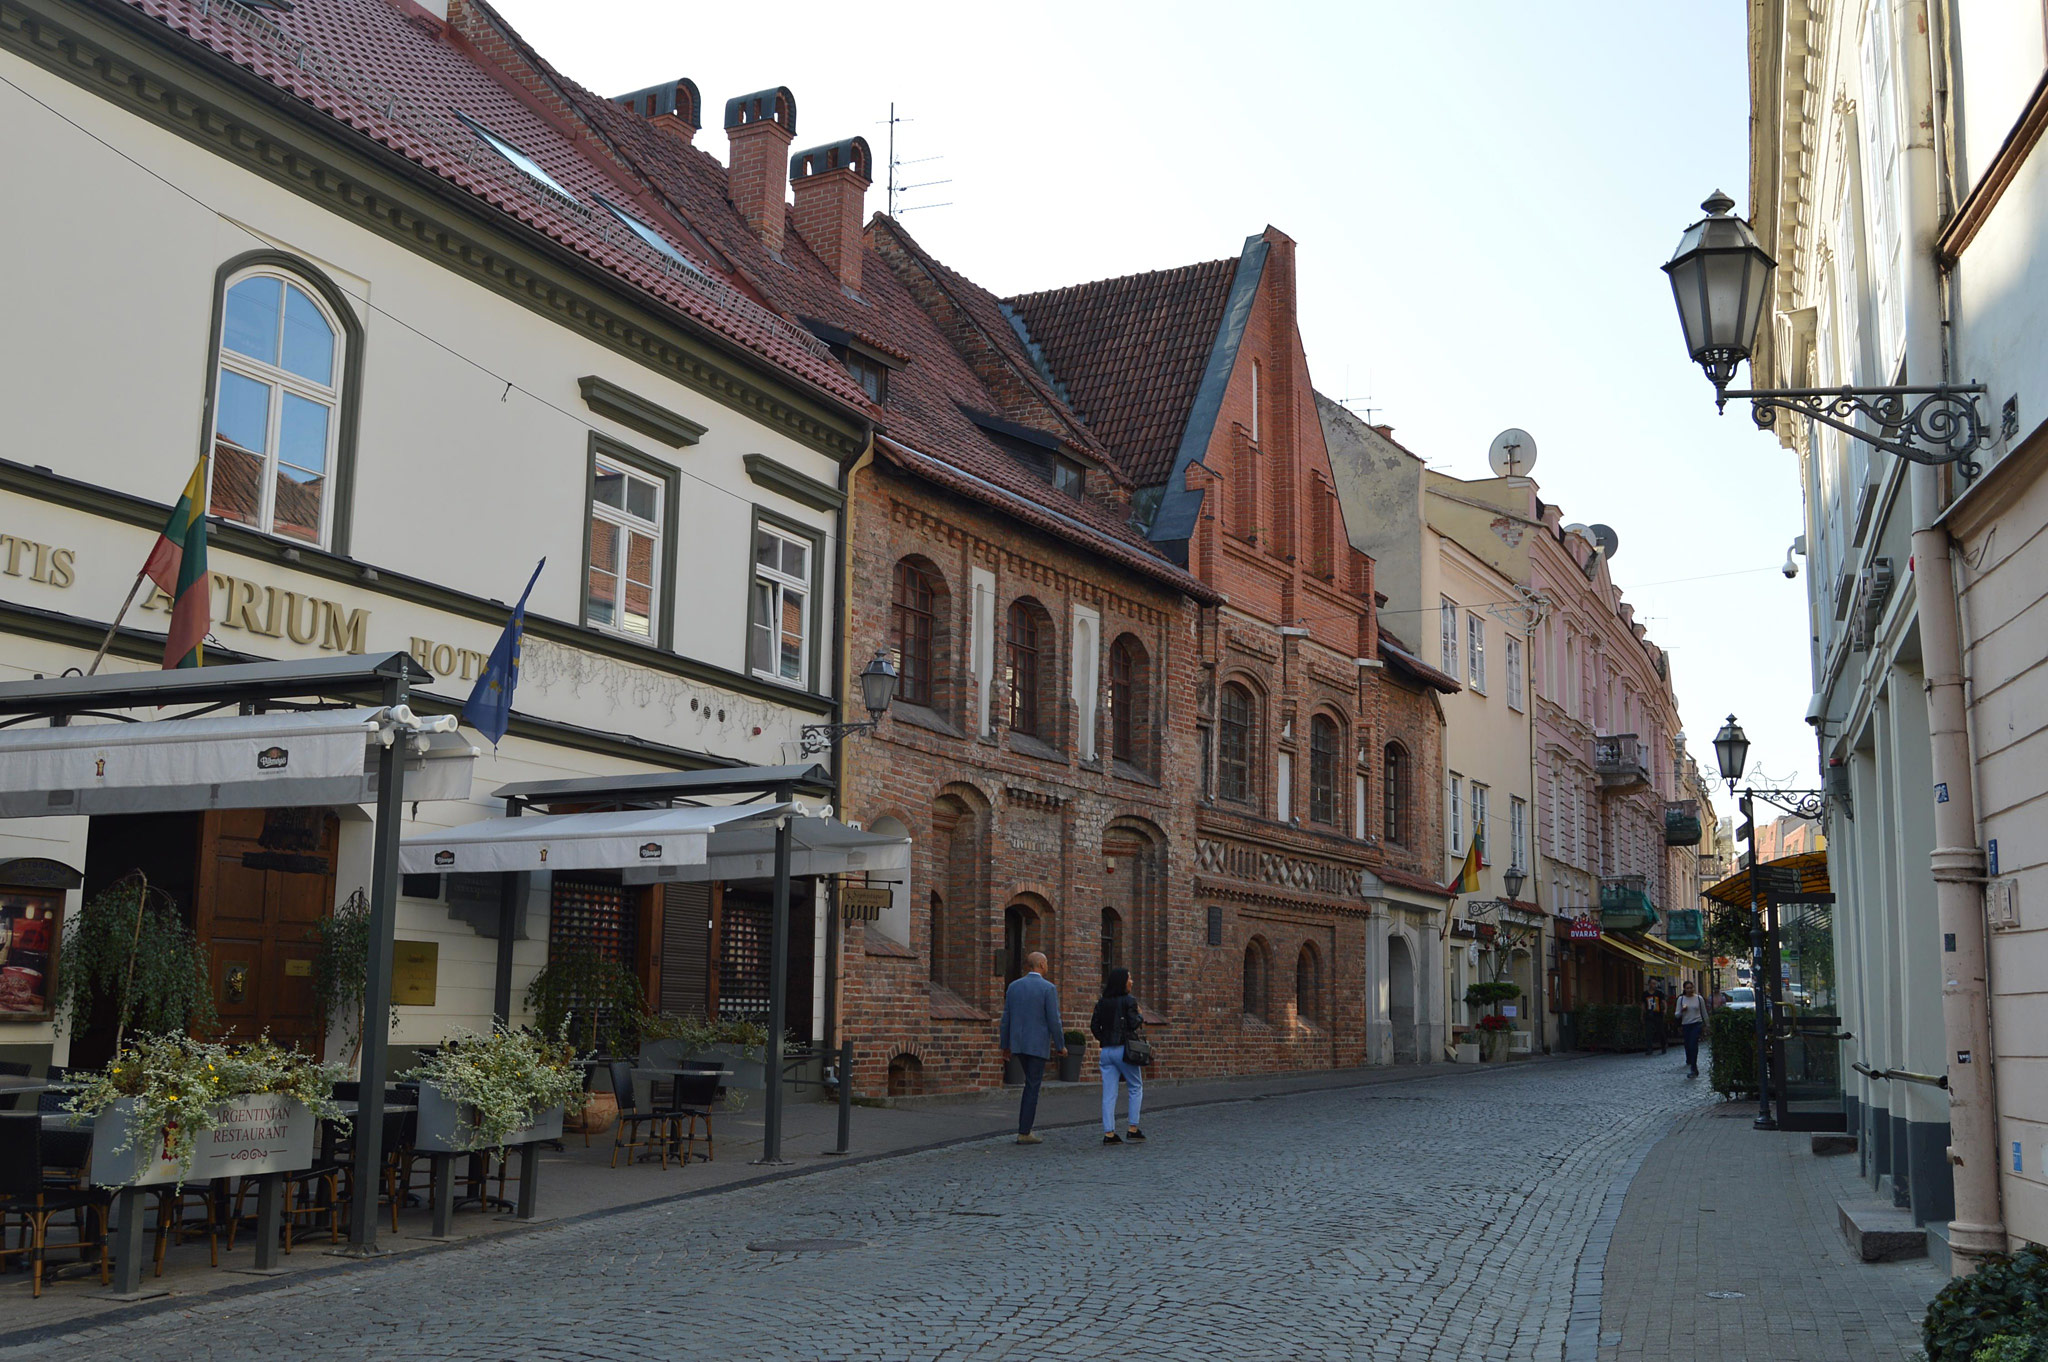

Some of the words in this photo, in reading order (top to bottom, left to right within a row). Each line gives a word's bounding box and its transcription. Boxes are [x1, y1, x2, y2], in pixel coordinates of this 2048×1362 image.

[409, 636, 490, 683] HOT
[1570, 930, 1598, 938] DVARAS
[216, 1106, 291, 1123] ARGENTINIAN
[213, 1126, 288, 1143] RESTAURANT
